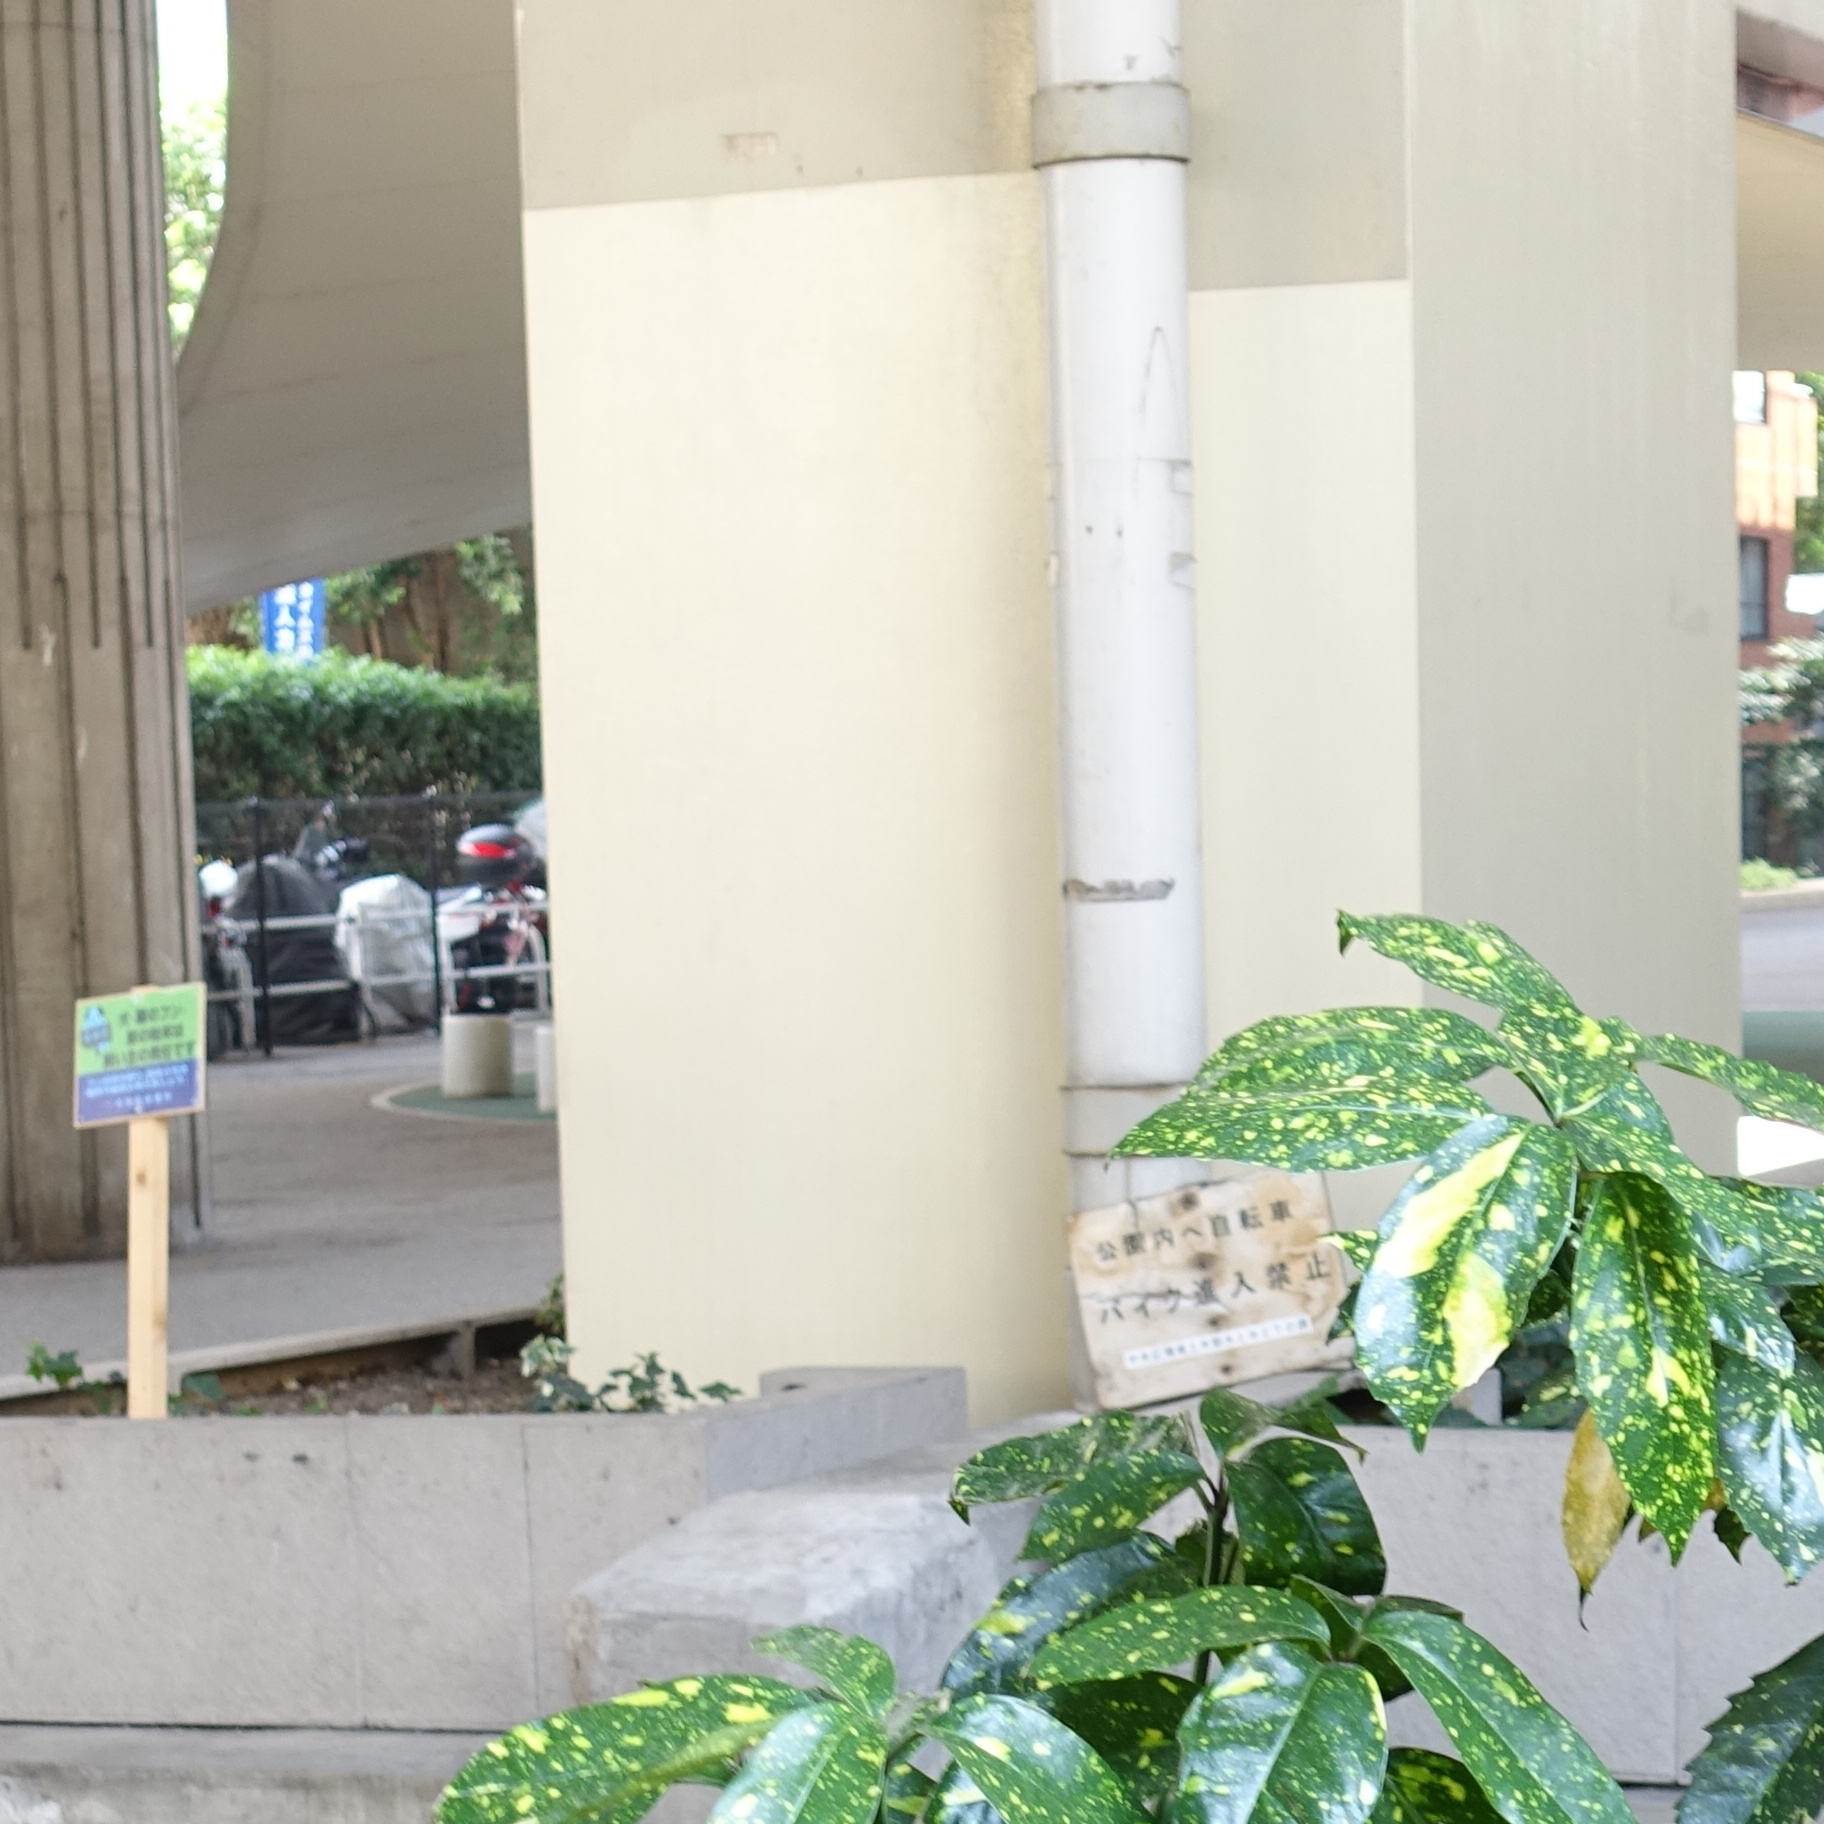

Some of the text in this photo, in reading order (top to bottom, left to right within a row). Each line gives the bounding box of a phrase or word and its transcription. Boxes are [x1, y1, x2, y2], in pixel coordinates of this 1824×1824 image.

[1095, 1199, 1293, 1263] 公園内へ自転車
